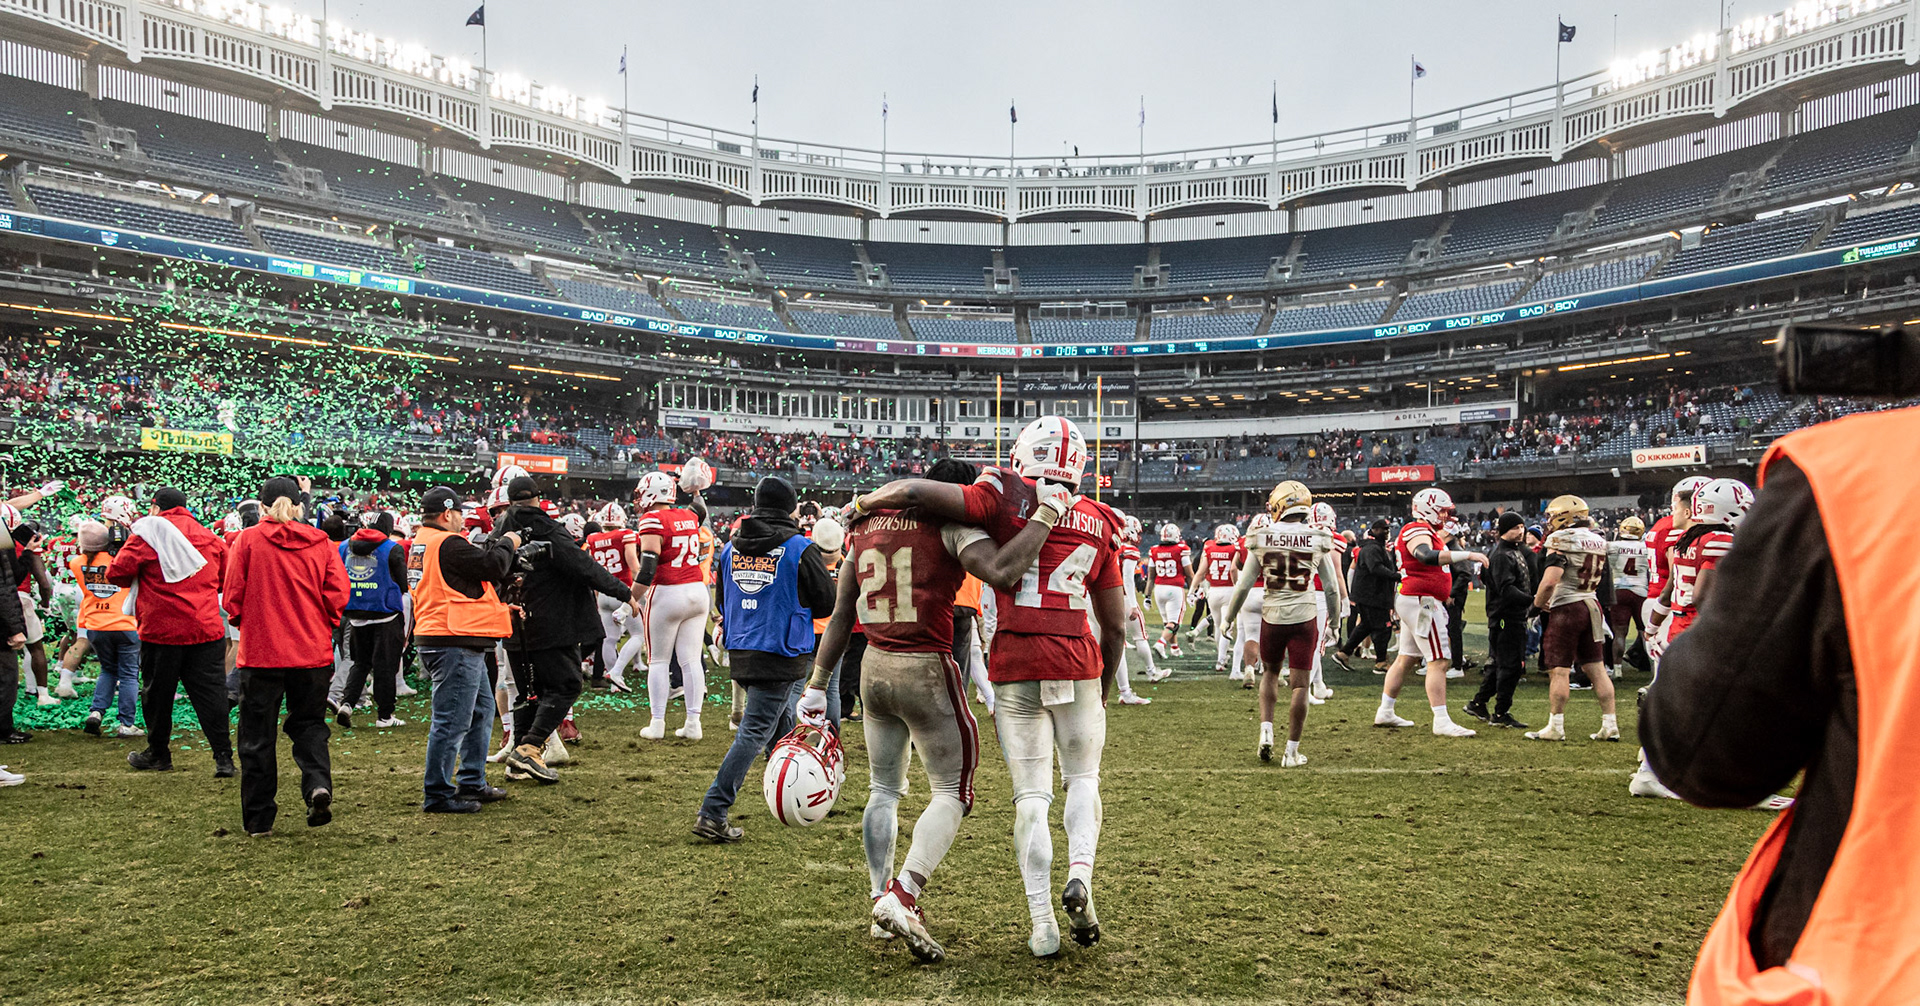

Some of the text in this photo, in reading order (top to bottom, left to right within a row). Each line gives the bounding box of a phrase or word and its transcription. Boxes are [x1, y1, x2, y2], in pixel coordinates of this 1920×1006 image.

[1859, 242, 1896, 255] TULLAMORE
[1520, 300, 1579, 317] BAD BOY
[581, 311, 636, 327] BAD BOY
[1446, 312, 1505, 328] BAD BOY
[648, 321, 701, 335] BAD BOY
[1375, 323, 1431, 337] BAD BOY
[715, 330, 768, 342] BAD BOY
[876, 342, 888, 351] BC
[916, 345, 925, 354] 15
[977, 346, 1016, 356] NEBRASKA
[1022, 348, 1032, 357] 20
[1056, 346, 1078, 356] 0:06
[1114, 346, 1126, 355] 25
[1068, 451, 1077, 466] 4
[1648, 452, 1690, 461] KIKKOMAN
[1044, 469, 1073, 480] HUSKERS
[1098, 475, 1112, 487] 25
[1732, 486, 1744, 504] N
[1018, 499, 1029, 519] R
[1697, 504, 1702, 514] 5
[1266, 535, 1312, 547] McSHANE
[671, 534, 700, 567] 79
[732, 562, 775, 572] MOWERS
[1156, 560, 1177, 577] 68
[1209, 560, 1231, 580] 47
[1263, 552, 1313, 591] 35
[1623, 558, 1638, 576] 4
[1015, 543, 1098, 609] 14
[856, 546, 918, 624] 21
[742, 599, 757, 609] 030
[807, 789, 827, 807] N
